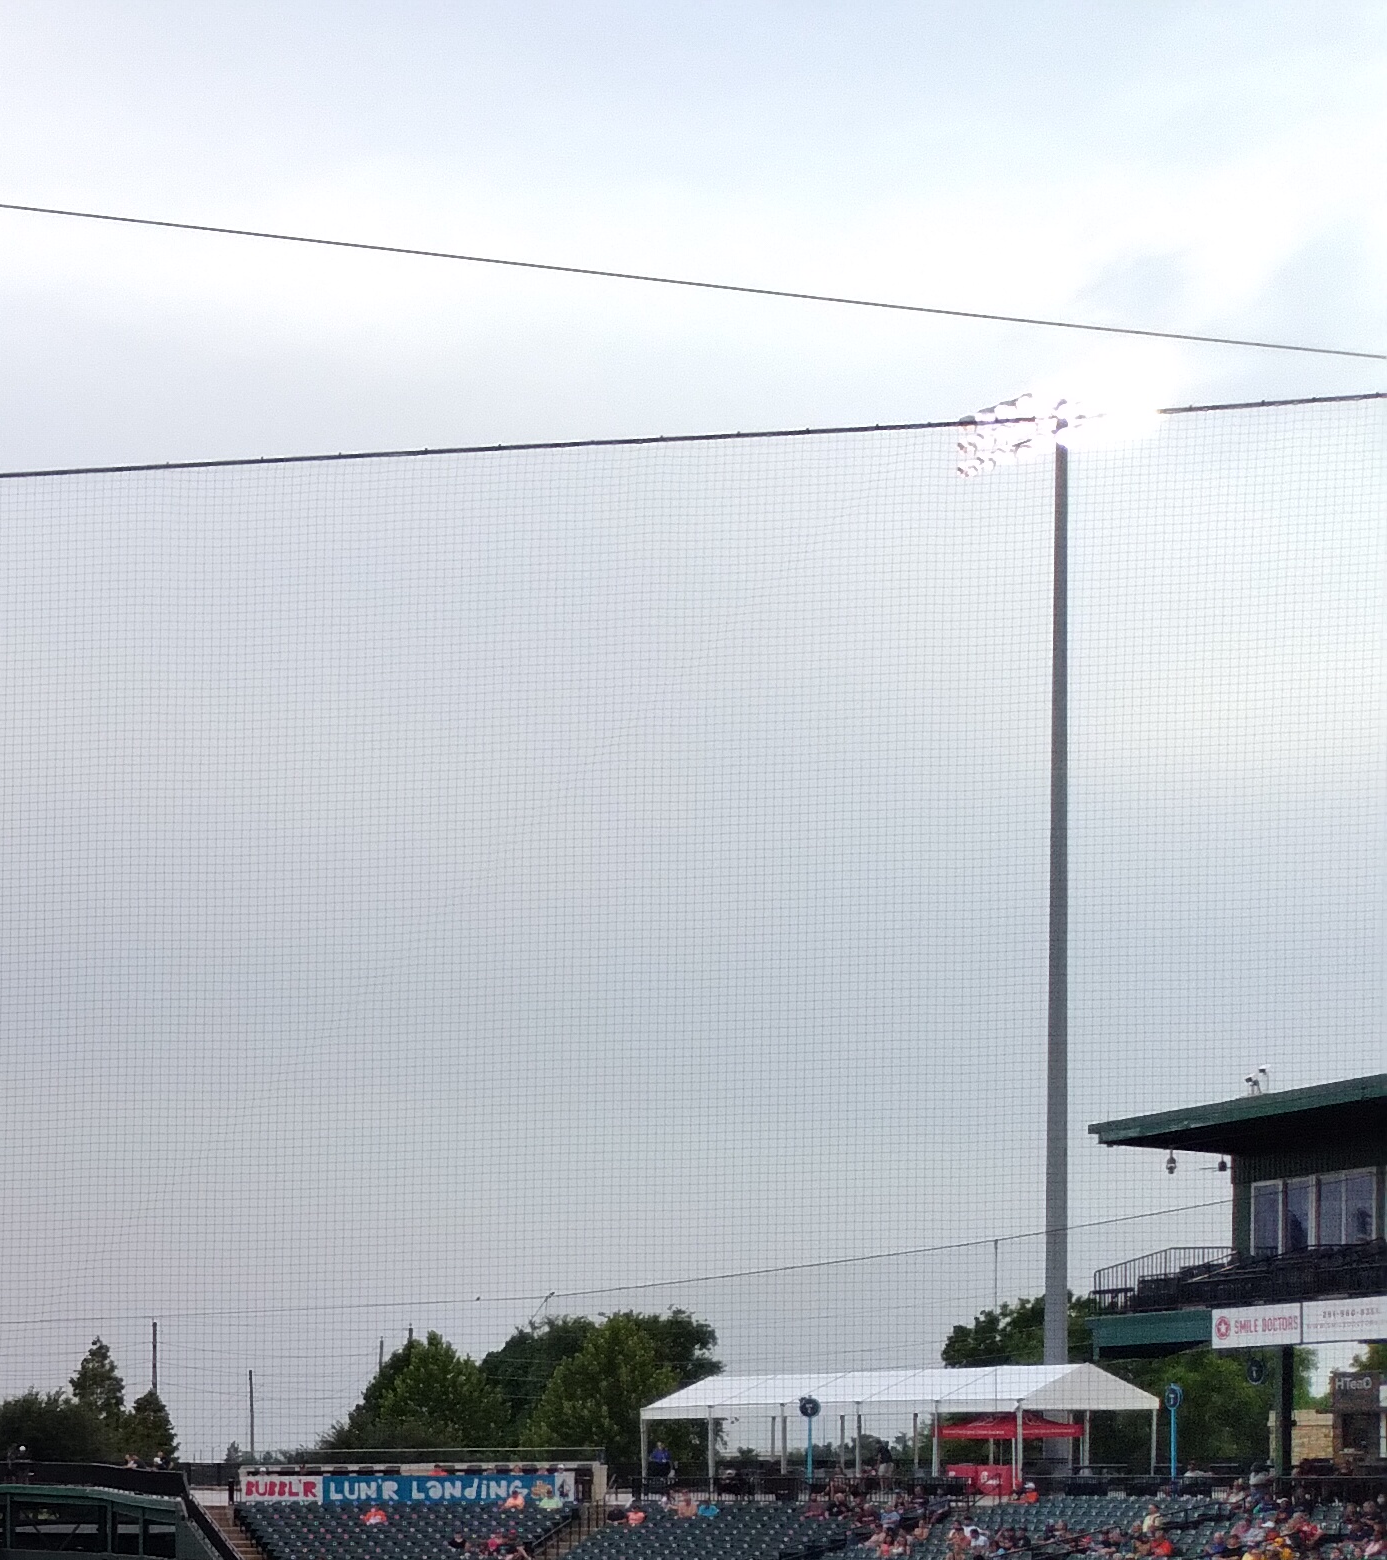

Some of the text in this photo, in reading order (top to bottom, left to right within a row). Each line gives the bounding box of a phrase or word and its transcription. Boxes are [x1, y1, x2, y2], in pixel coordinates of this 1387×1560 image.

[1234, 1318, 1258, 1334] SMILE
[1262, 1316, 1298, 1332] DOCTORS
[245, 1479, 398, 1500] BUBBL'R LUN'R
